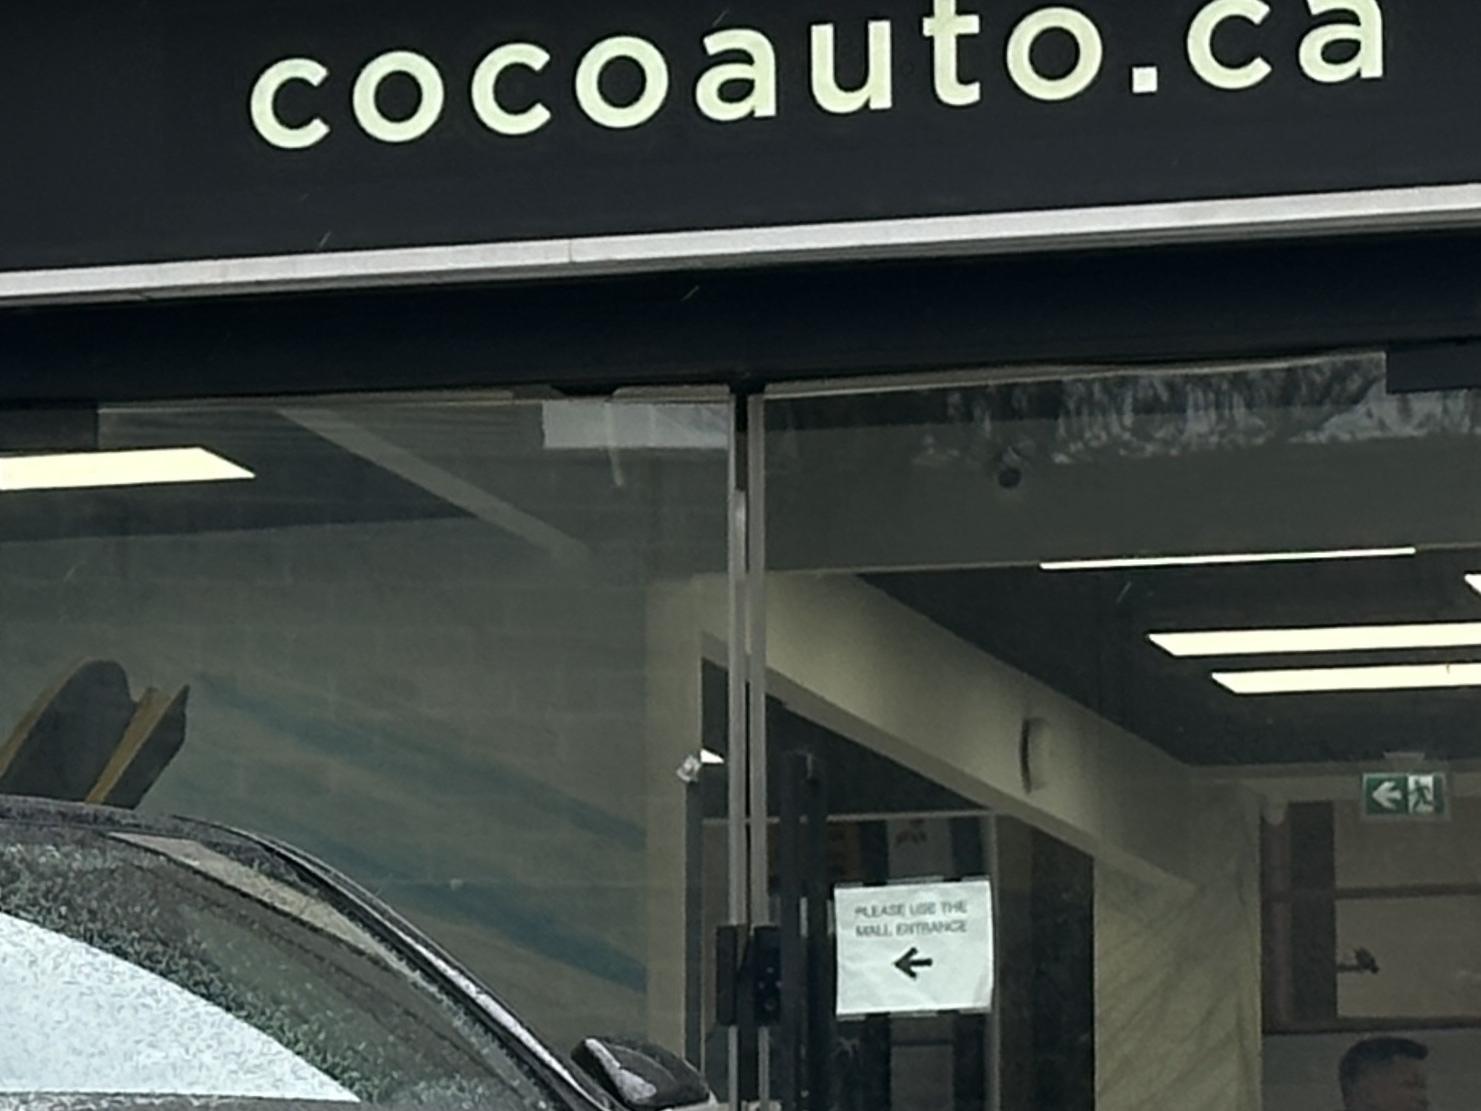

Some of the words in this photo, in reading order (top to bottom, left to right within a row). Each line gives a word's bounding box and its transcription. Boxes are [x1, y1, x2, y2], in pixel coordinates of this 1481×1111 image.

[250, 0, 1384, 149] cocoauto.ca
[854, 902, 905, 918] PLEASE
[909, 901, 936, 916] USE
[940, 900, 968, 914] THE
[895, 919, 968, 936] ENTRANCE
